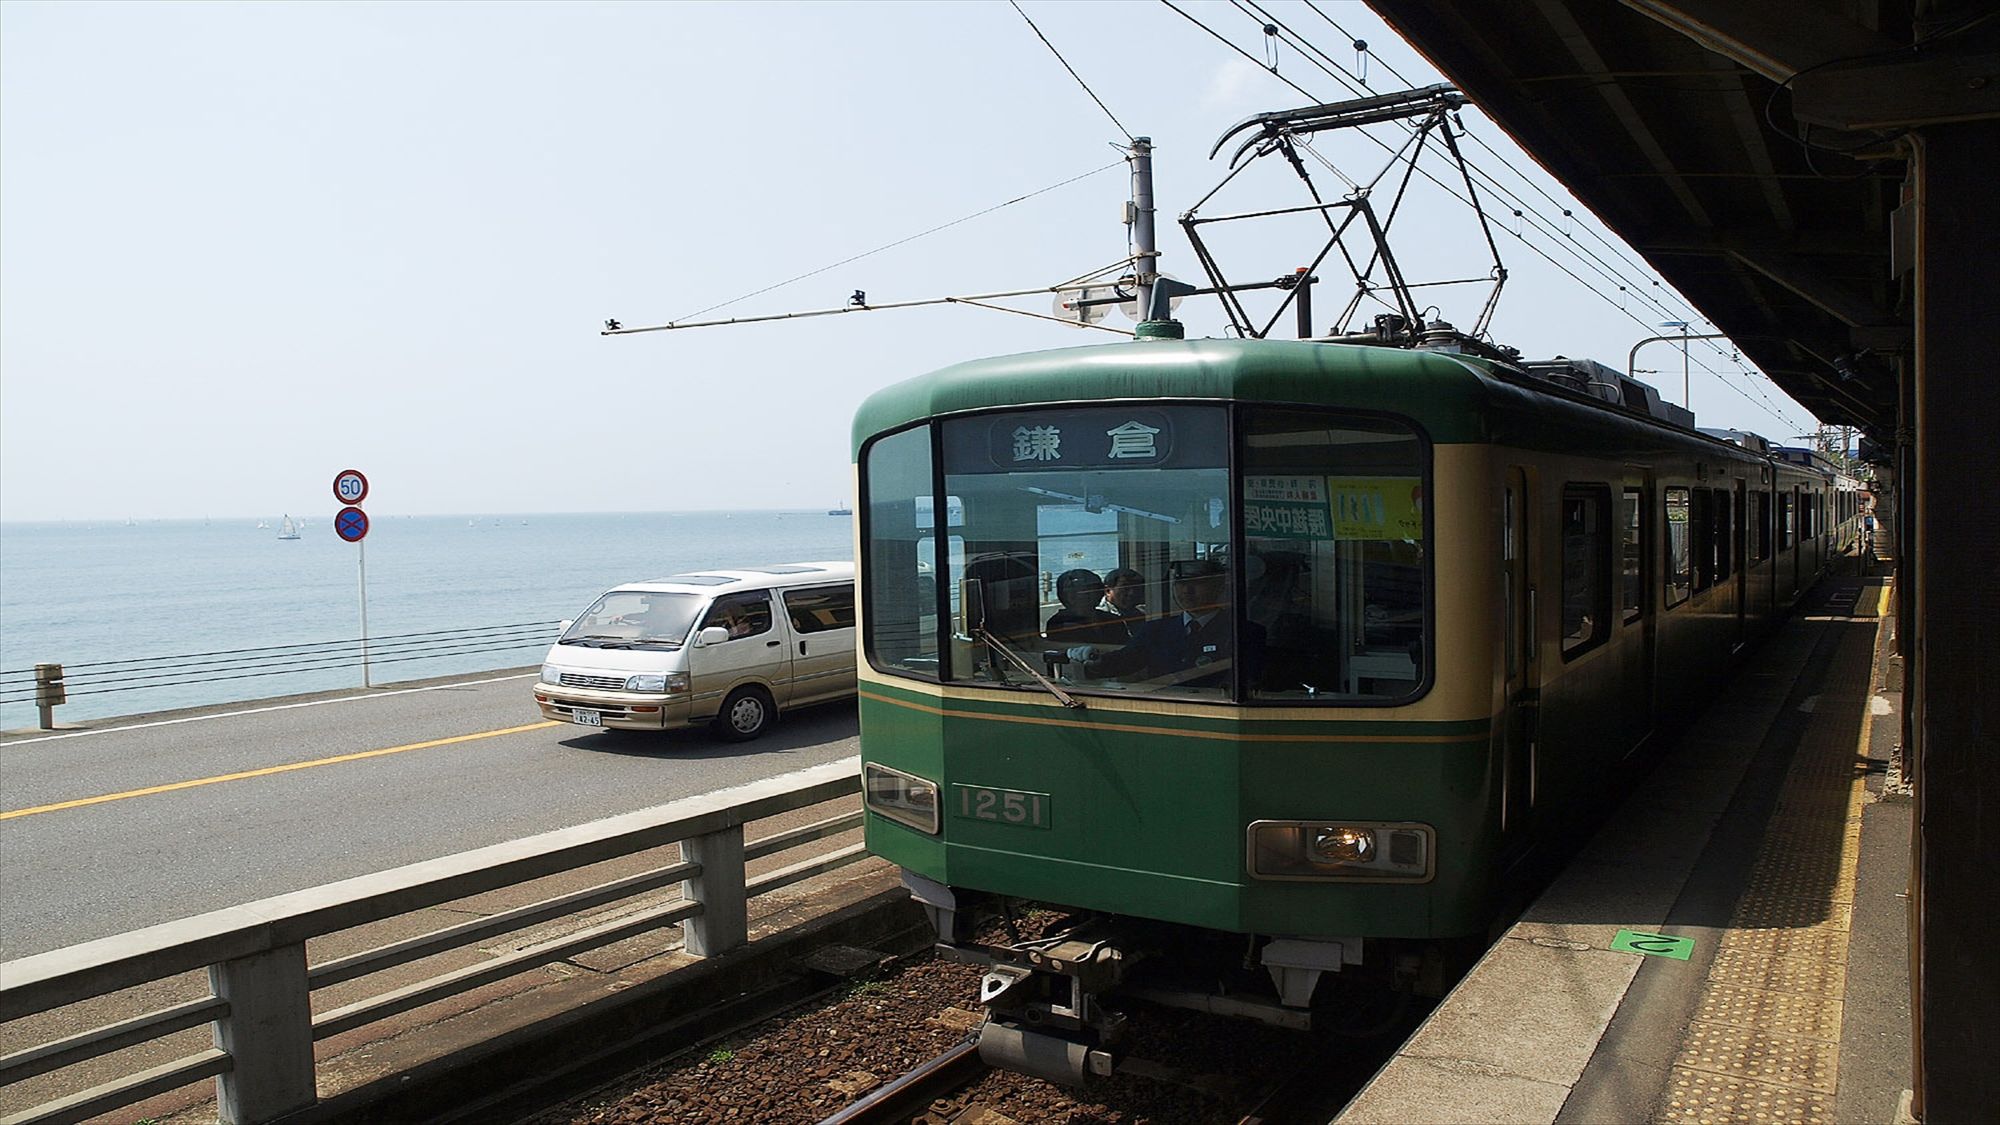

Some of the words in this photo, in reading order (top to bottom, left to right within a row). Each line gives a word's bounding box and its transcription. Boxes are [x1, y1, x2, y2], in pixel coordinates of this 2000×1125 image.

[1012, 420, 1161, 462] 鎌倉
[340, 479, 361, 496] 50
[961, 787, 1040, 825] 1251
[1629, 933, 1681, 953] 2
